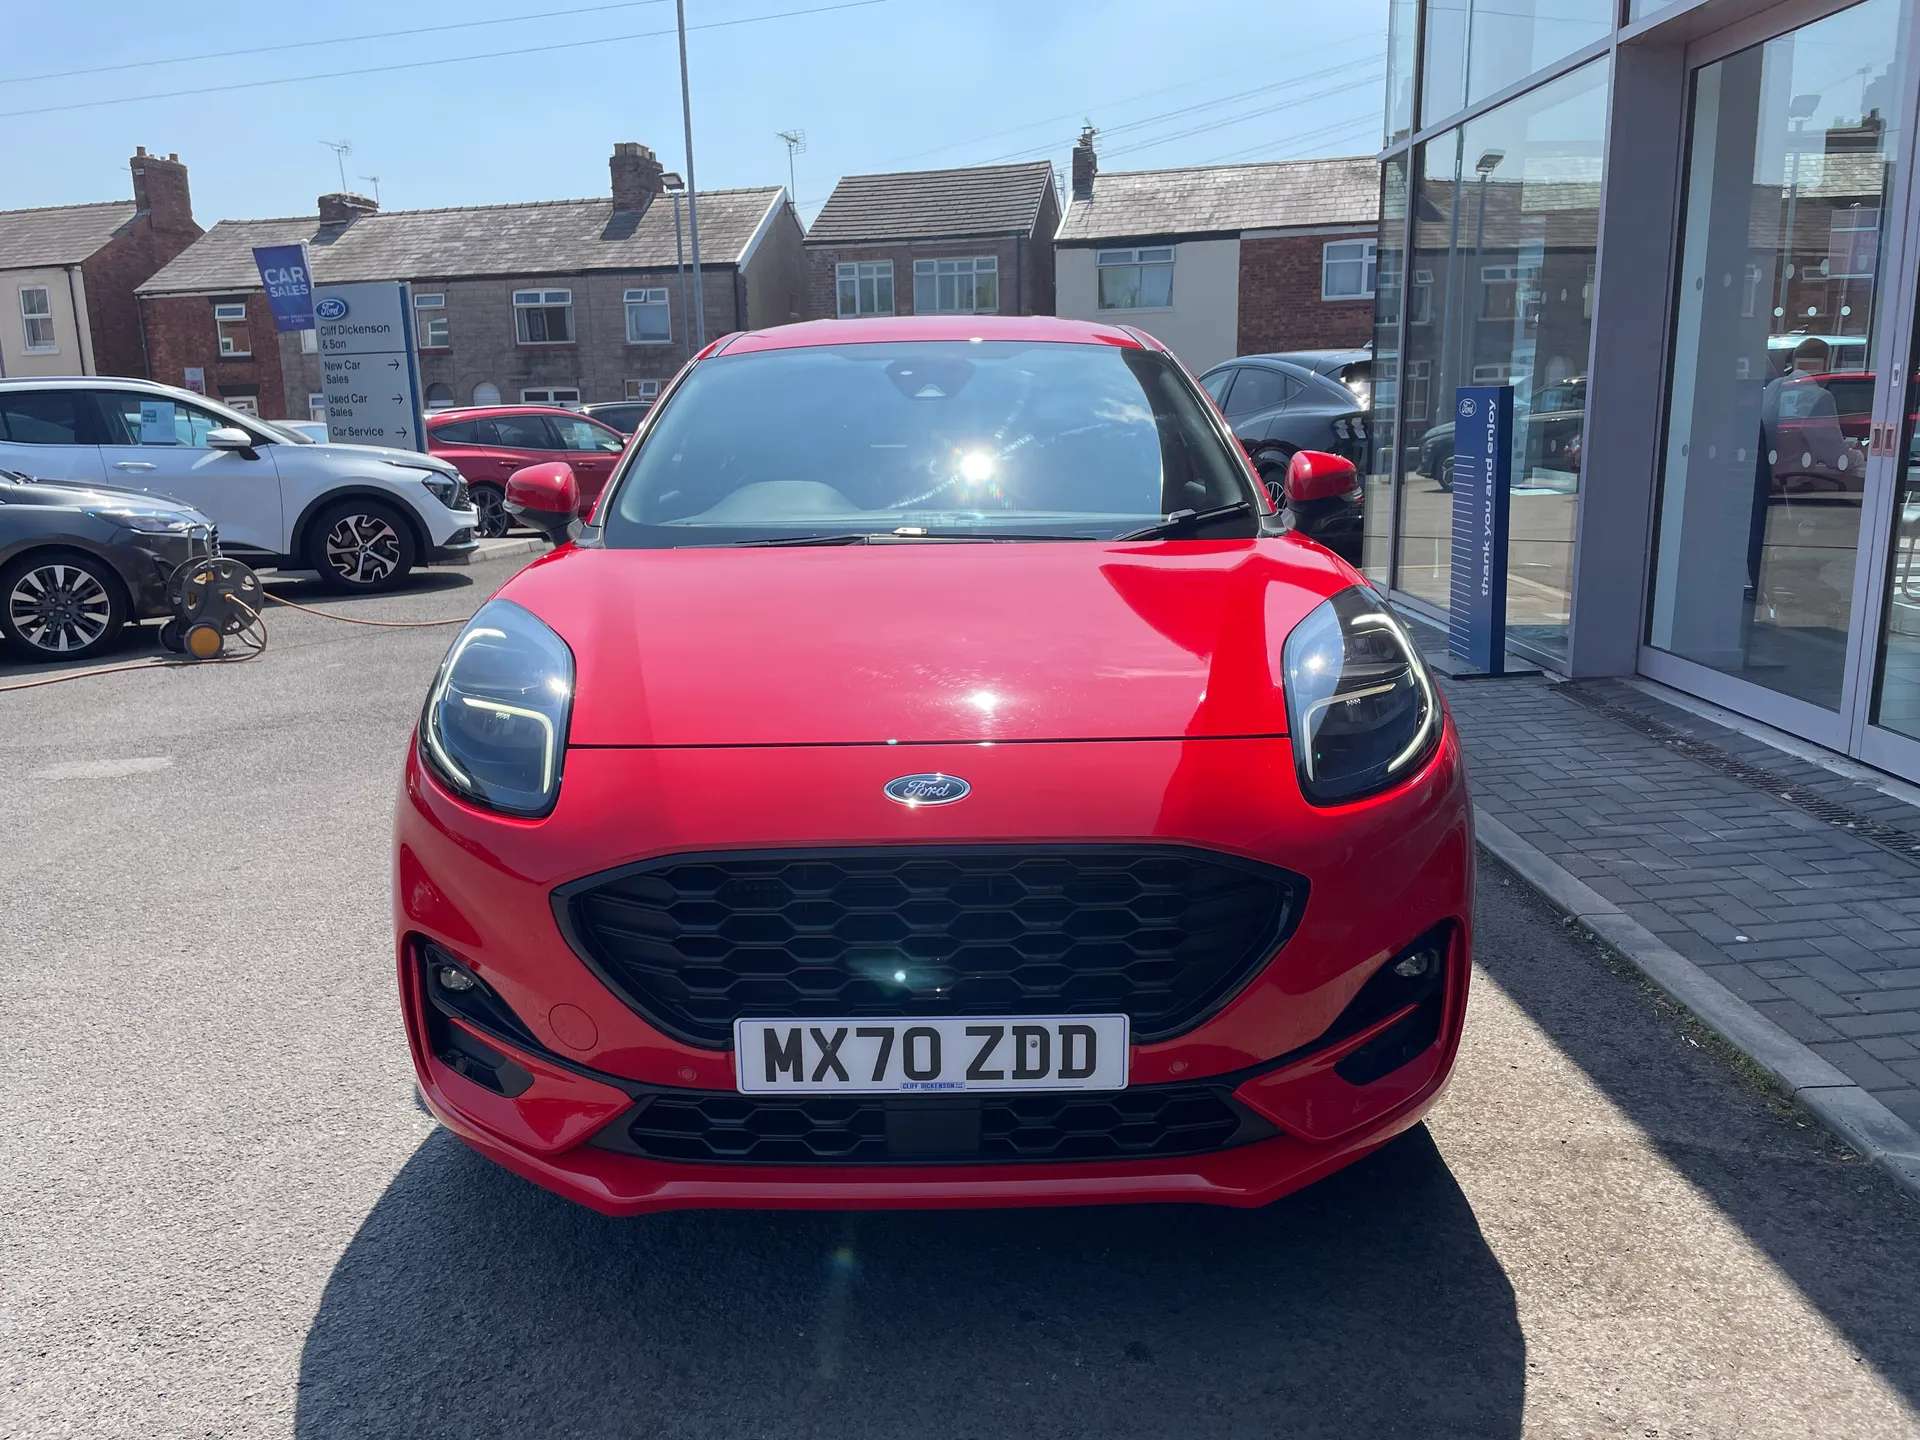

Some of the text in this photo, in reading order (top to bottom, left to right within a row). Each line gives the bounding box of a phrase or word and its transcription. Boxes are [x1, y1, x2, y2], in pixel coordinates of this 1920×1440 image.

[264, 266, 306, 285] CAR
[270, 284, 309, 298] SALES
[320, 302, 340, 316] Ford
[320, 324, 390, 336] Cliff Dickenson
[322, 339, 347, 350] & Son
[324, 359, 360, 371] New Car
[326, 374, 349, 385] Sales
[328, 393, 368, 404] Used Car
[330, 407, 353, 417] Sales
[332, 426, 384, 437] Car Service
[1486, 399, 1496, 454] enjoy
[1485, 457, 1493, 497] and
[1481, 540, 1490, 597] thank
[903, 779, 950, 797] Ford
[763, 1024, 1097, 1082] MX70 ZDD
